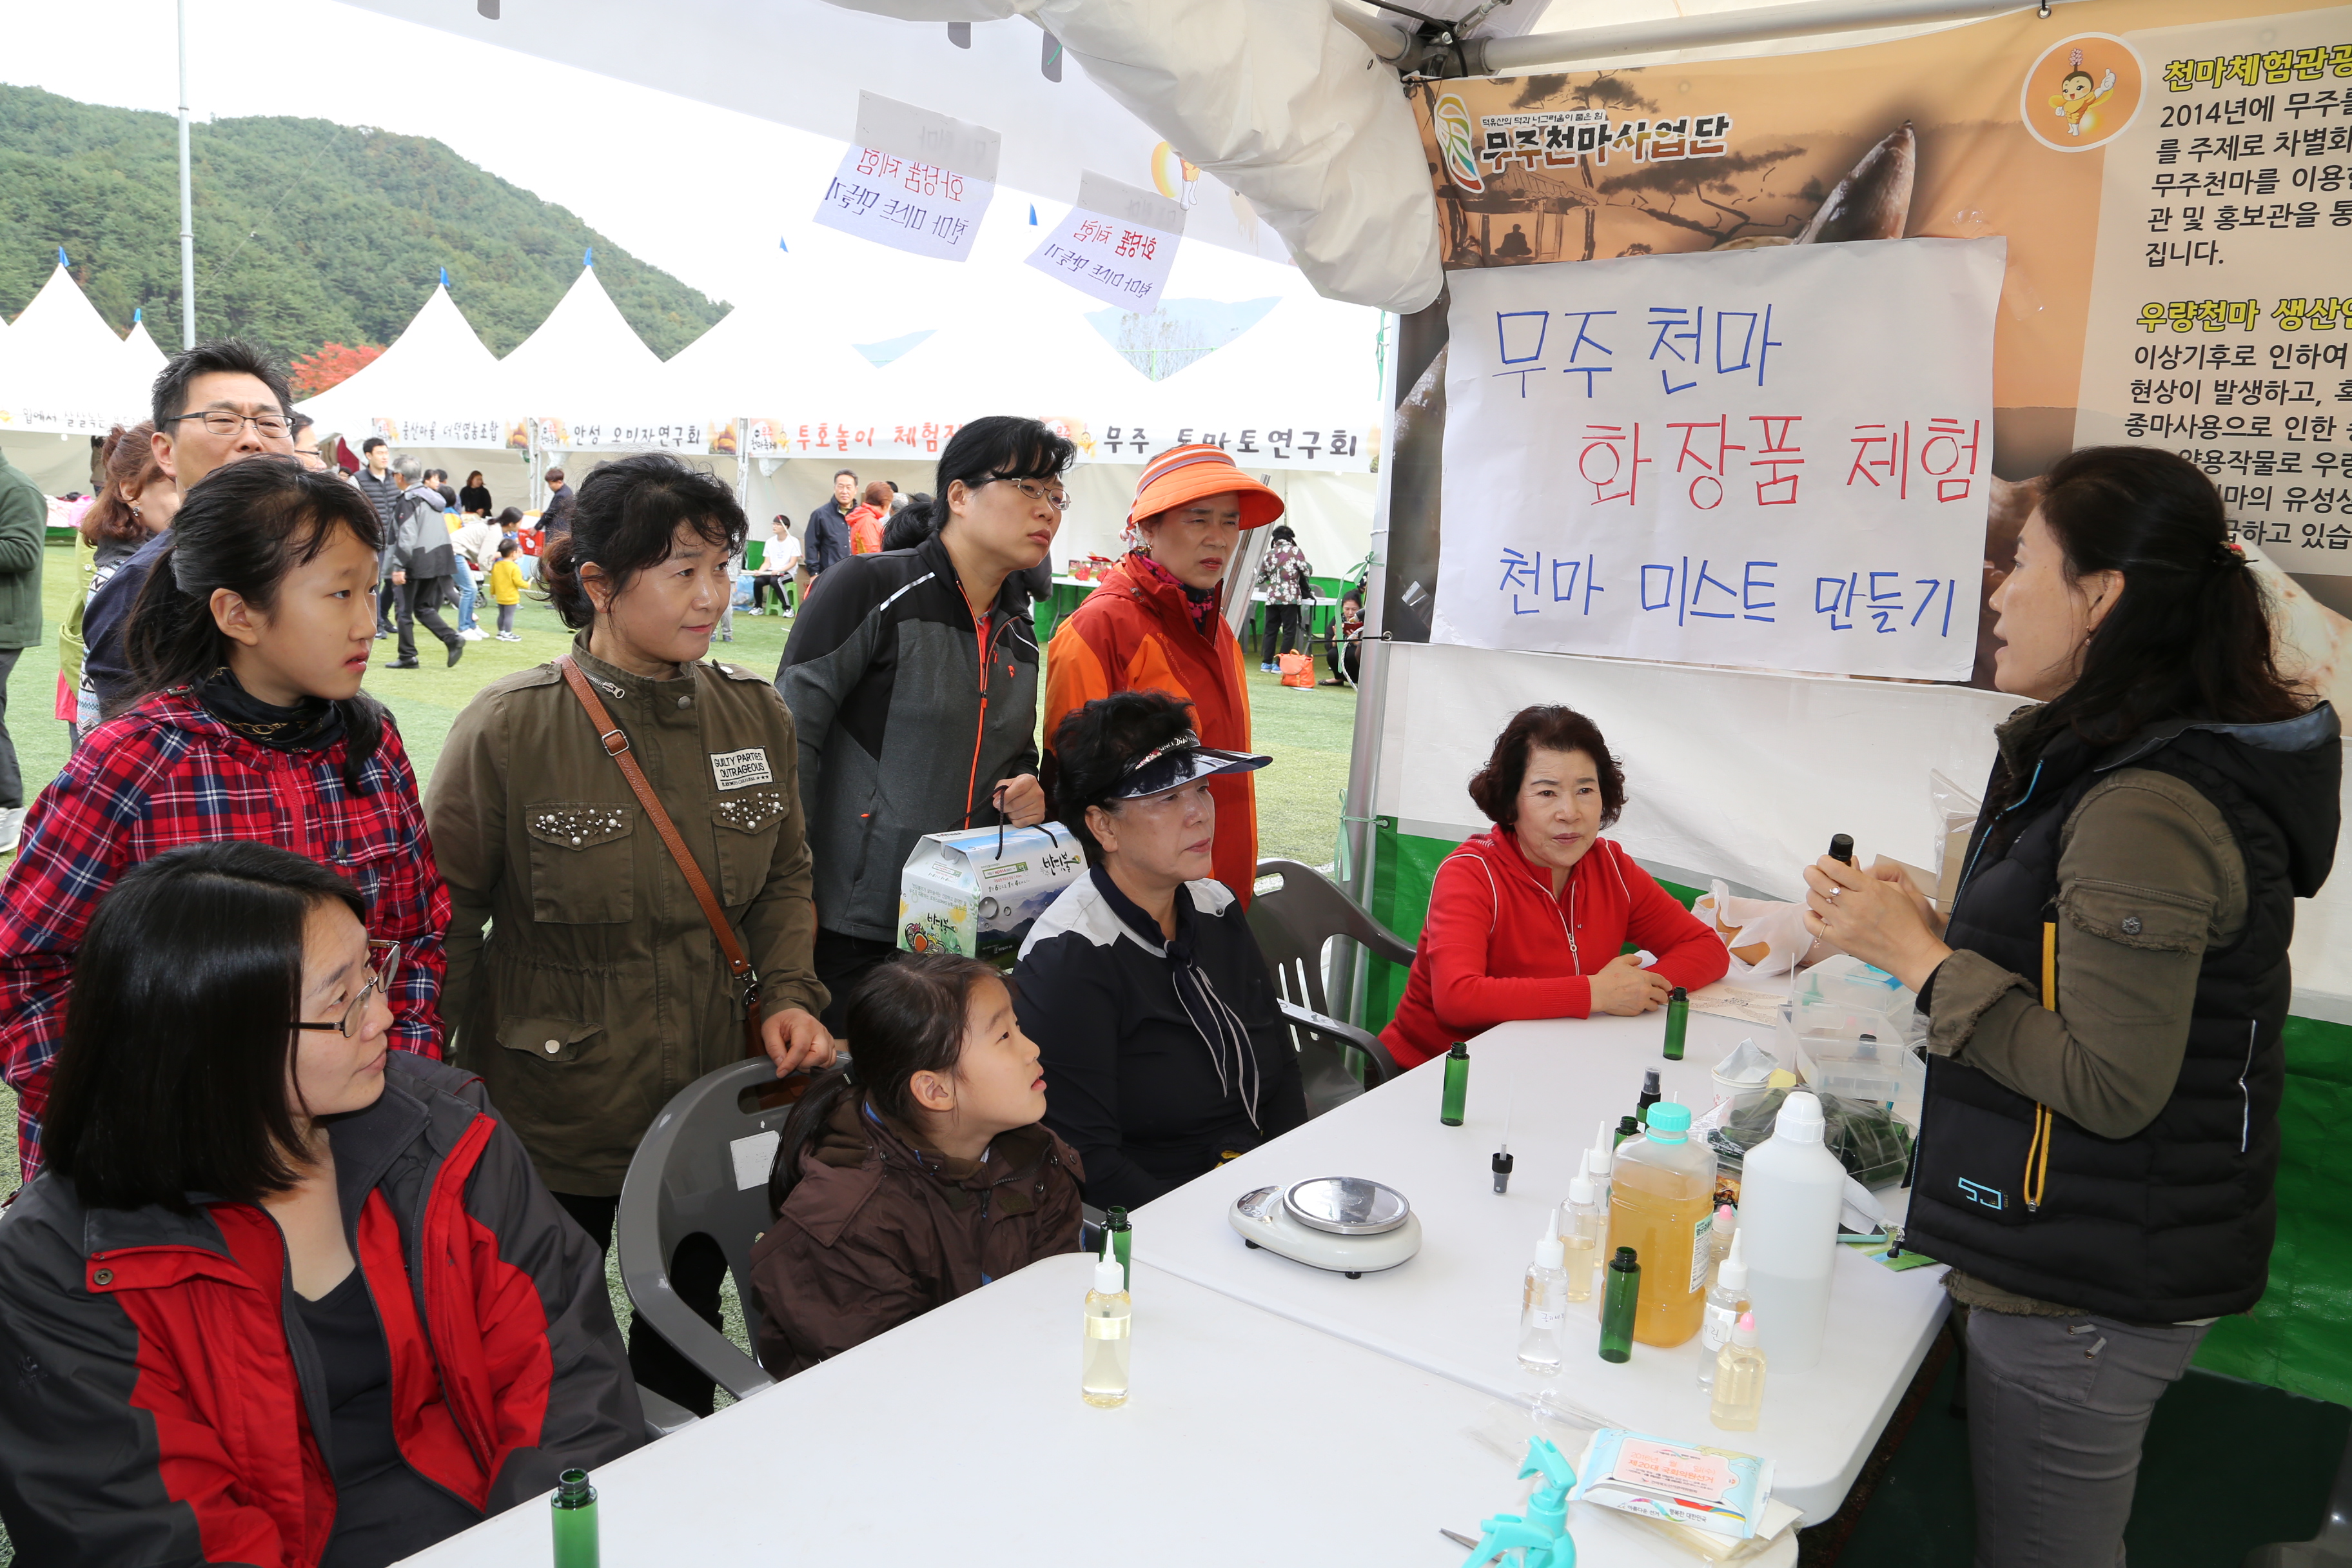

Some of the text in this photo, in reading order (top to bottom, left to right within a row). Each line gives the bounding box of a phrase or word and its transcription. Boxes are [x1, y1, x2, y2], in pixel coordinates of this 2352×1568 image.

[1482, 117, 1511, 126] 덕유산의
[1514, 115, 1529, 124] 덕과
[1533, 113, 1573, 124] 너그러움이
[1594, 112, 1602, 120] 힘
[2161, 95, 2275, 128] 2014년에
[1483, 115, 1730, 171] 무주천마사업단
[2155, 125, 2352, 165] 를 주제로 차별화
[2151, 164, 2352, 198] 무주천마를 이용
[2147, 201, 2352, 233] 관 및 홍보관을 통
[2145, 240, 2224, 268] 집니다.
[2136, 300, 2260, 333] 우량천마
[1492, 303, 1782, 398] 무주 천마
[2134, 343, 2348, 371] 이상기후로 인하여
[2130, 378, 2202, 405] 현상이
[2213, 378, 2322, 407] 발생하고,
[23, 407, 57, 424] 입에서
[64, 411, 105, 427] 살살녹는
[443, 420, 499, 442] 더덕영농조합
[2124, 413, 2273, 440] 종마사용으로
[2284, 415, 2337, 441] 인한
[573, 424, 700, 447] 안성 오미자연구회
[796, 422, 874, 452] 투호놀이
[1103, 425, 1357, 460] 무주 토마토연구회
[1578, 413, 1980, 510] 화장품 체험
[2217, 485, 2273, 512] 마의
[2301, 523, 2352, 551] 있습
[1499, 547, 1955, 638] 천마 미스트 만들기
[714, 752, 763, 767] GUILTY PARTIES
[1158, 741, 1174, 752] SINCE
[720, 763, 764, 777] OUTRAGEOUS
[1628, 1458, 1659, 1471] 제20대
[1661, 1465, 1714, 1484] 국회의원선거
[1631, 1451, 1658, 1464] 2016년
[1627, 1504, 1647, 1516] 아름다운
[1669, 1507, 1685, 1518] 행복한
[1685, 1511, 1707, 1523] 대한민국
